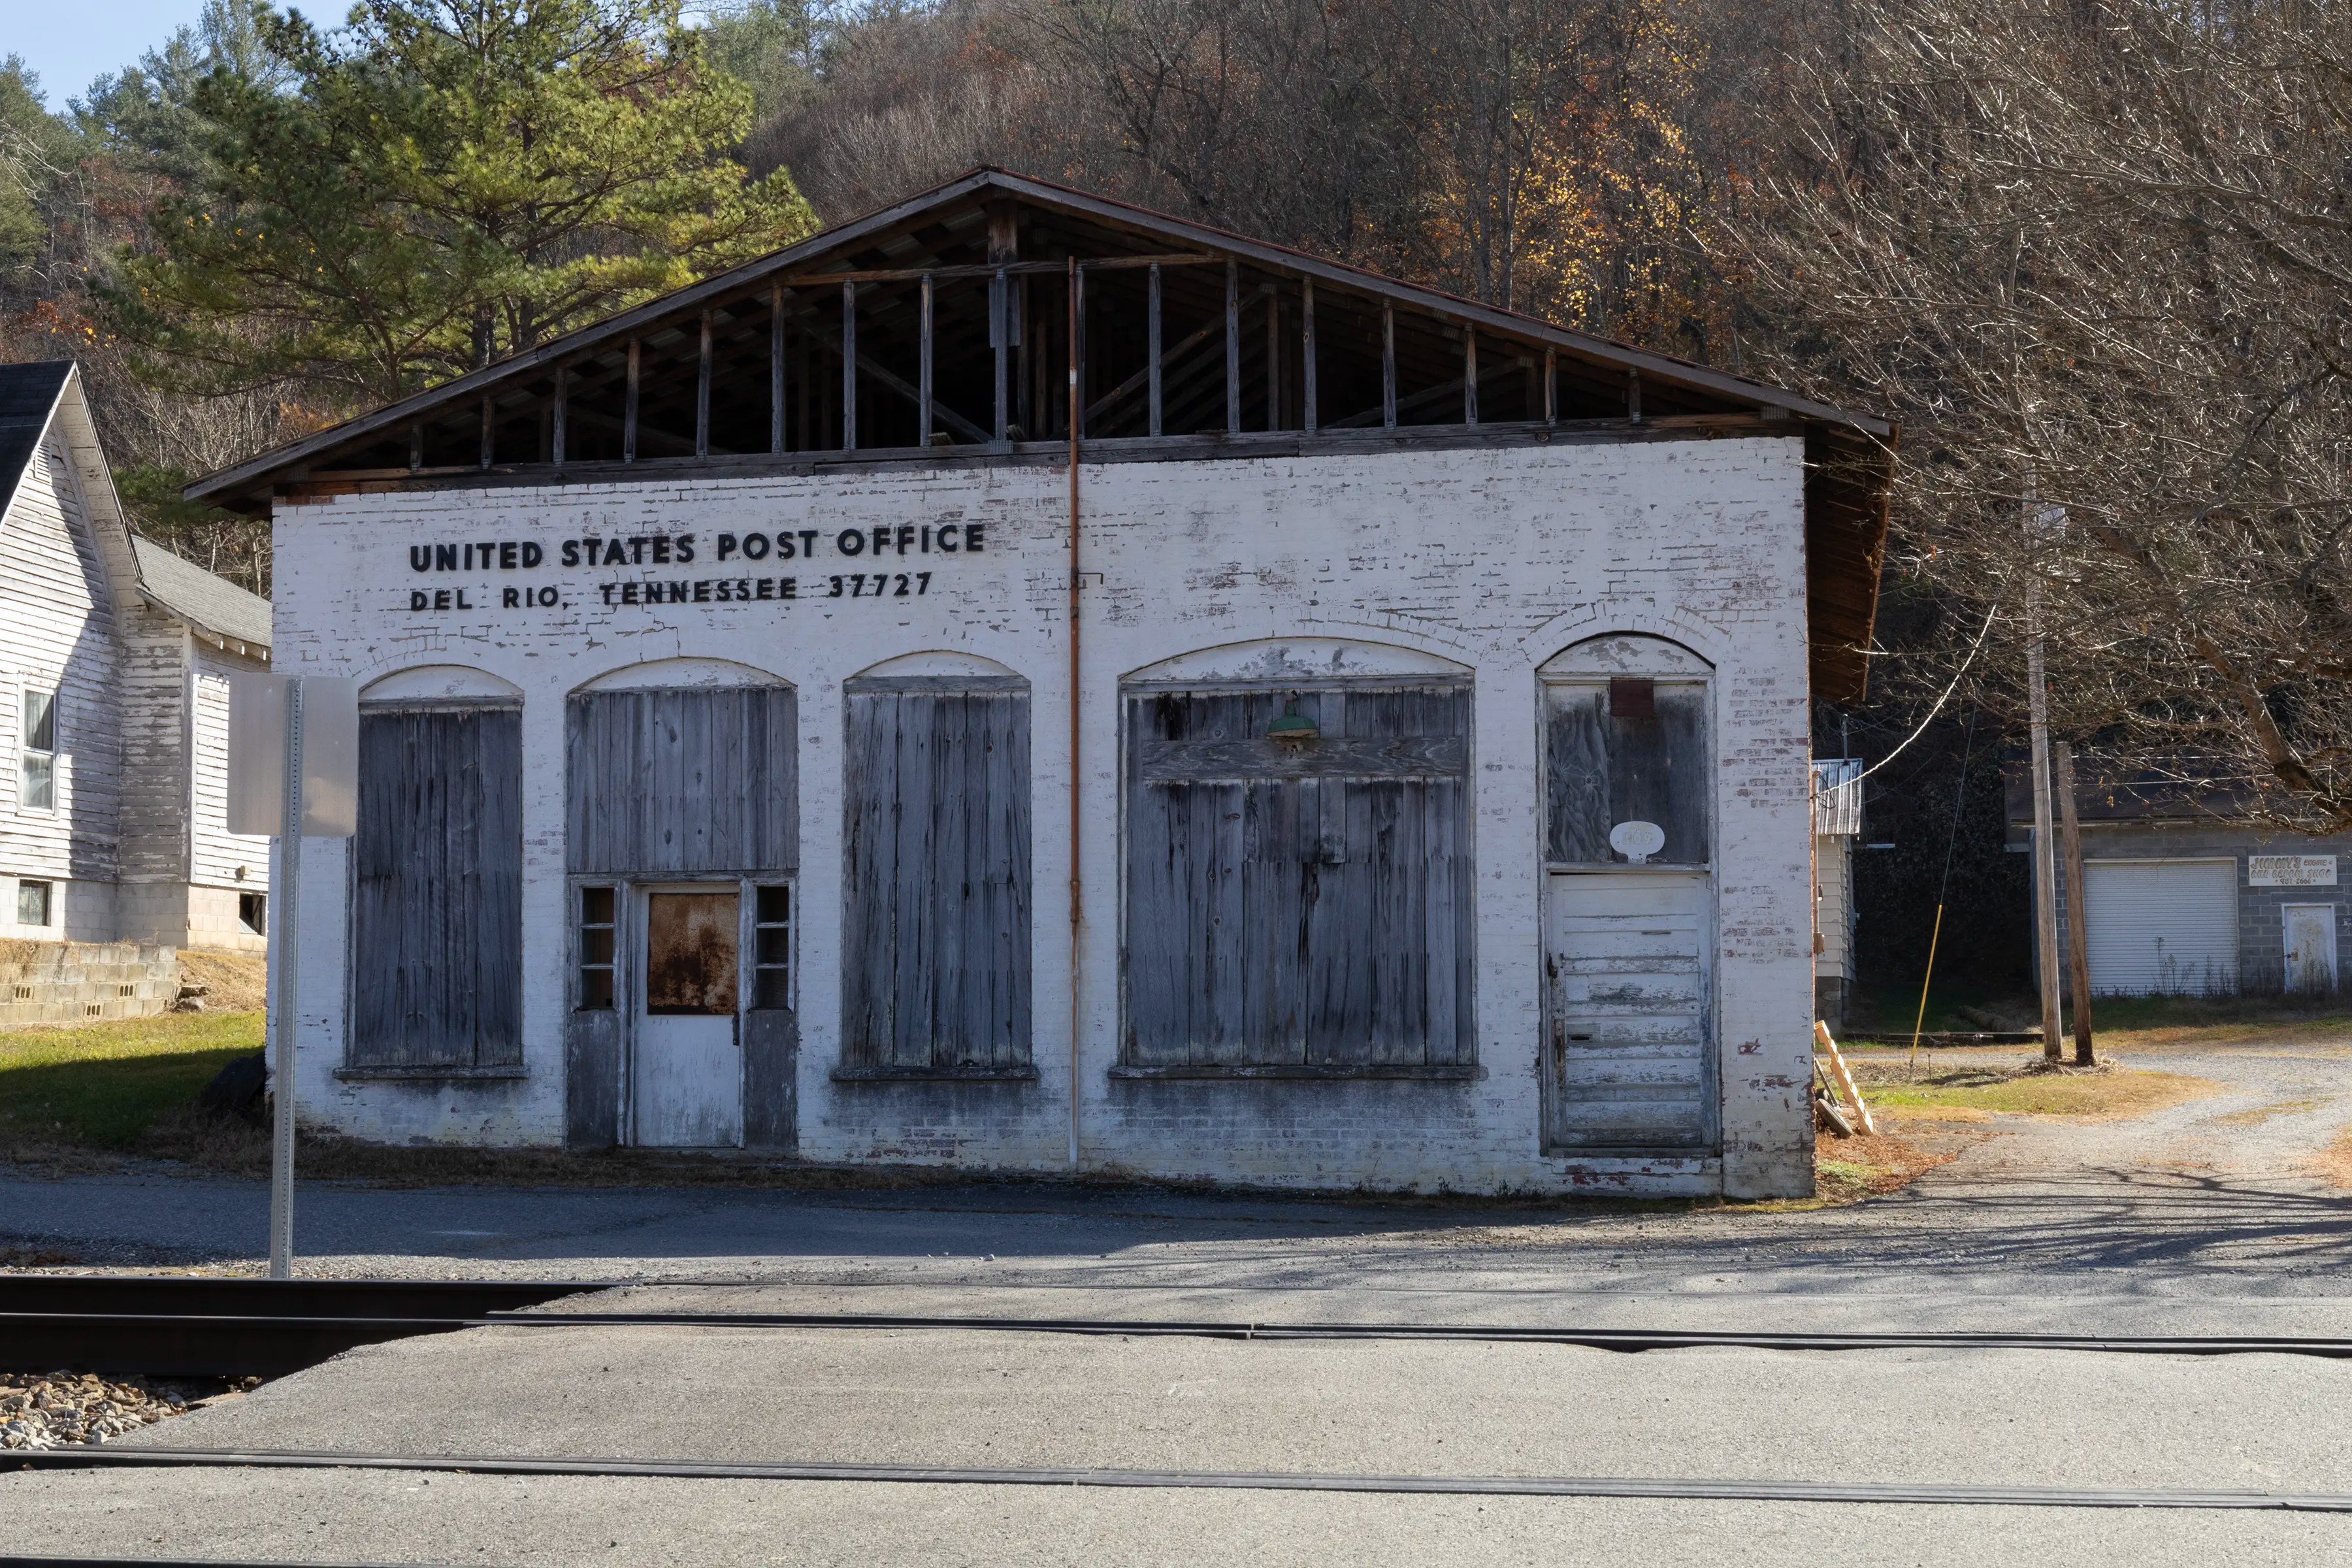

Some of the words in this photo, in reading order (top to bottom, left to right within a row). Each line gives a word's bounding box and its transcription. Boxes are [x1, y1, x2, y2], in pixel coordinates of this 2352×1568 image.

[410, 541, 543, 572] UNITED
[561, 535, 695, 566] STATES
[717, 529, 819, 561] POST
[836, 524, 985, 556] OFFICE
[410, 589, 473, 612] DEL
[502, 585, 570, 611] RIO,
[598, 579, 796, 606] TENNESSEE
[828, 572, 932, 598] 37727
[2249, 857, 2302, 869] JIMMY'S
[2250, 870, 2269, 879] AND
[2307, 869, 2332, 878] SHOP
